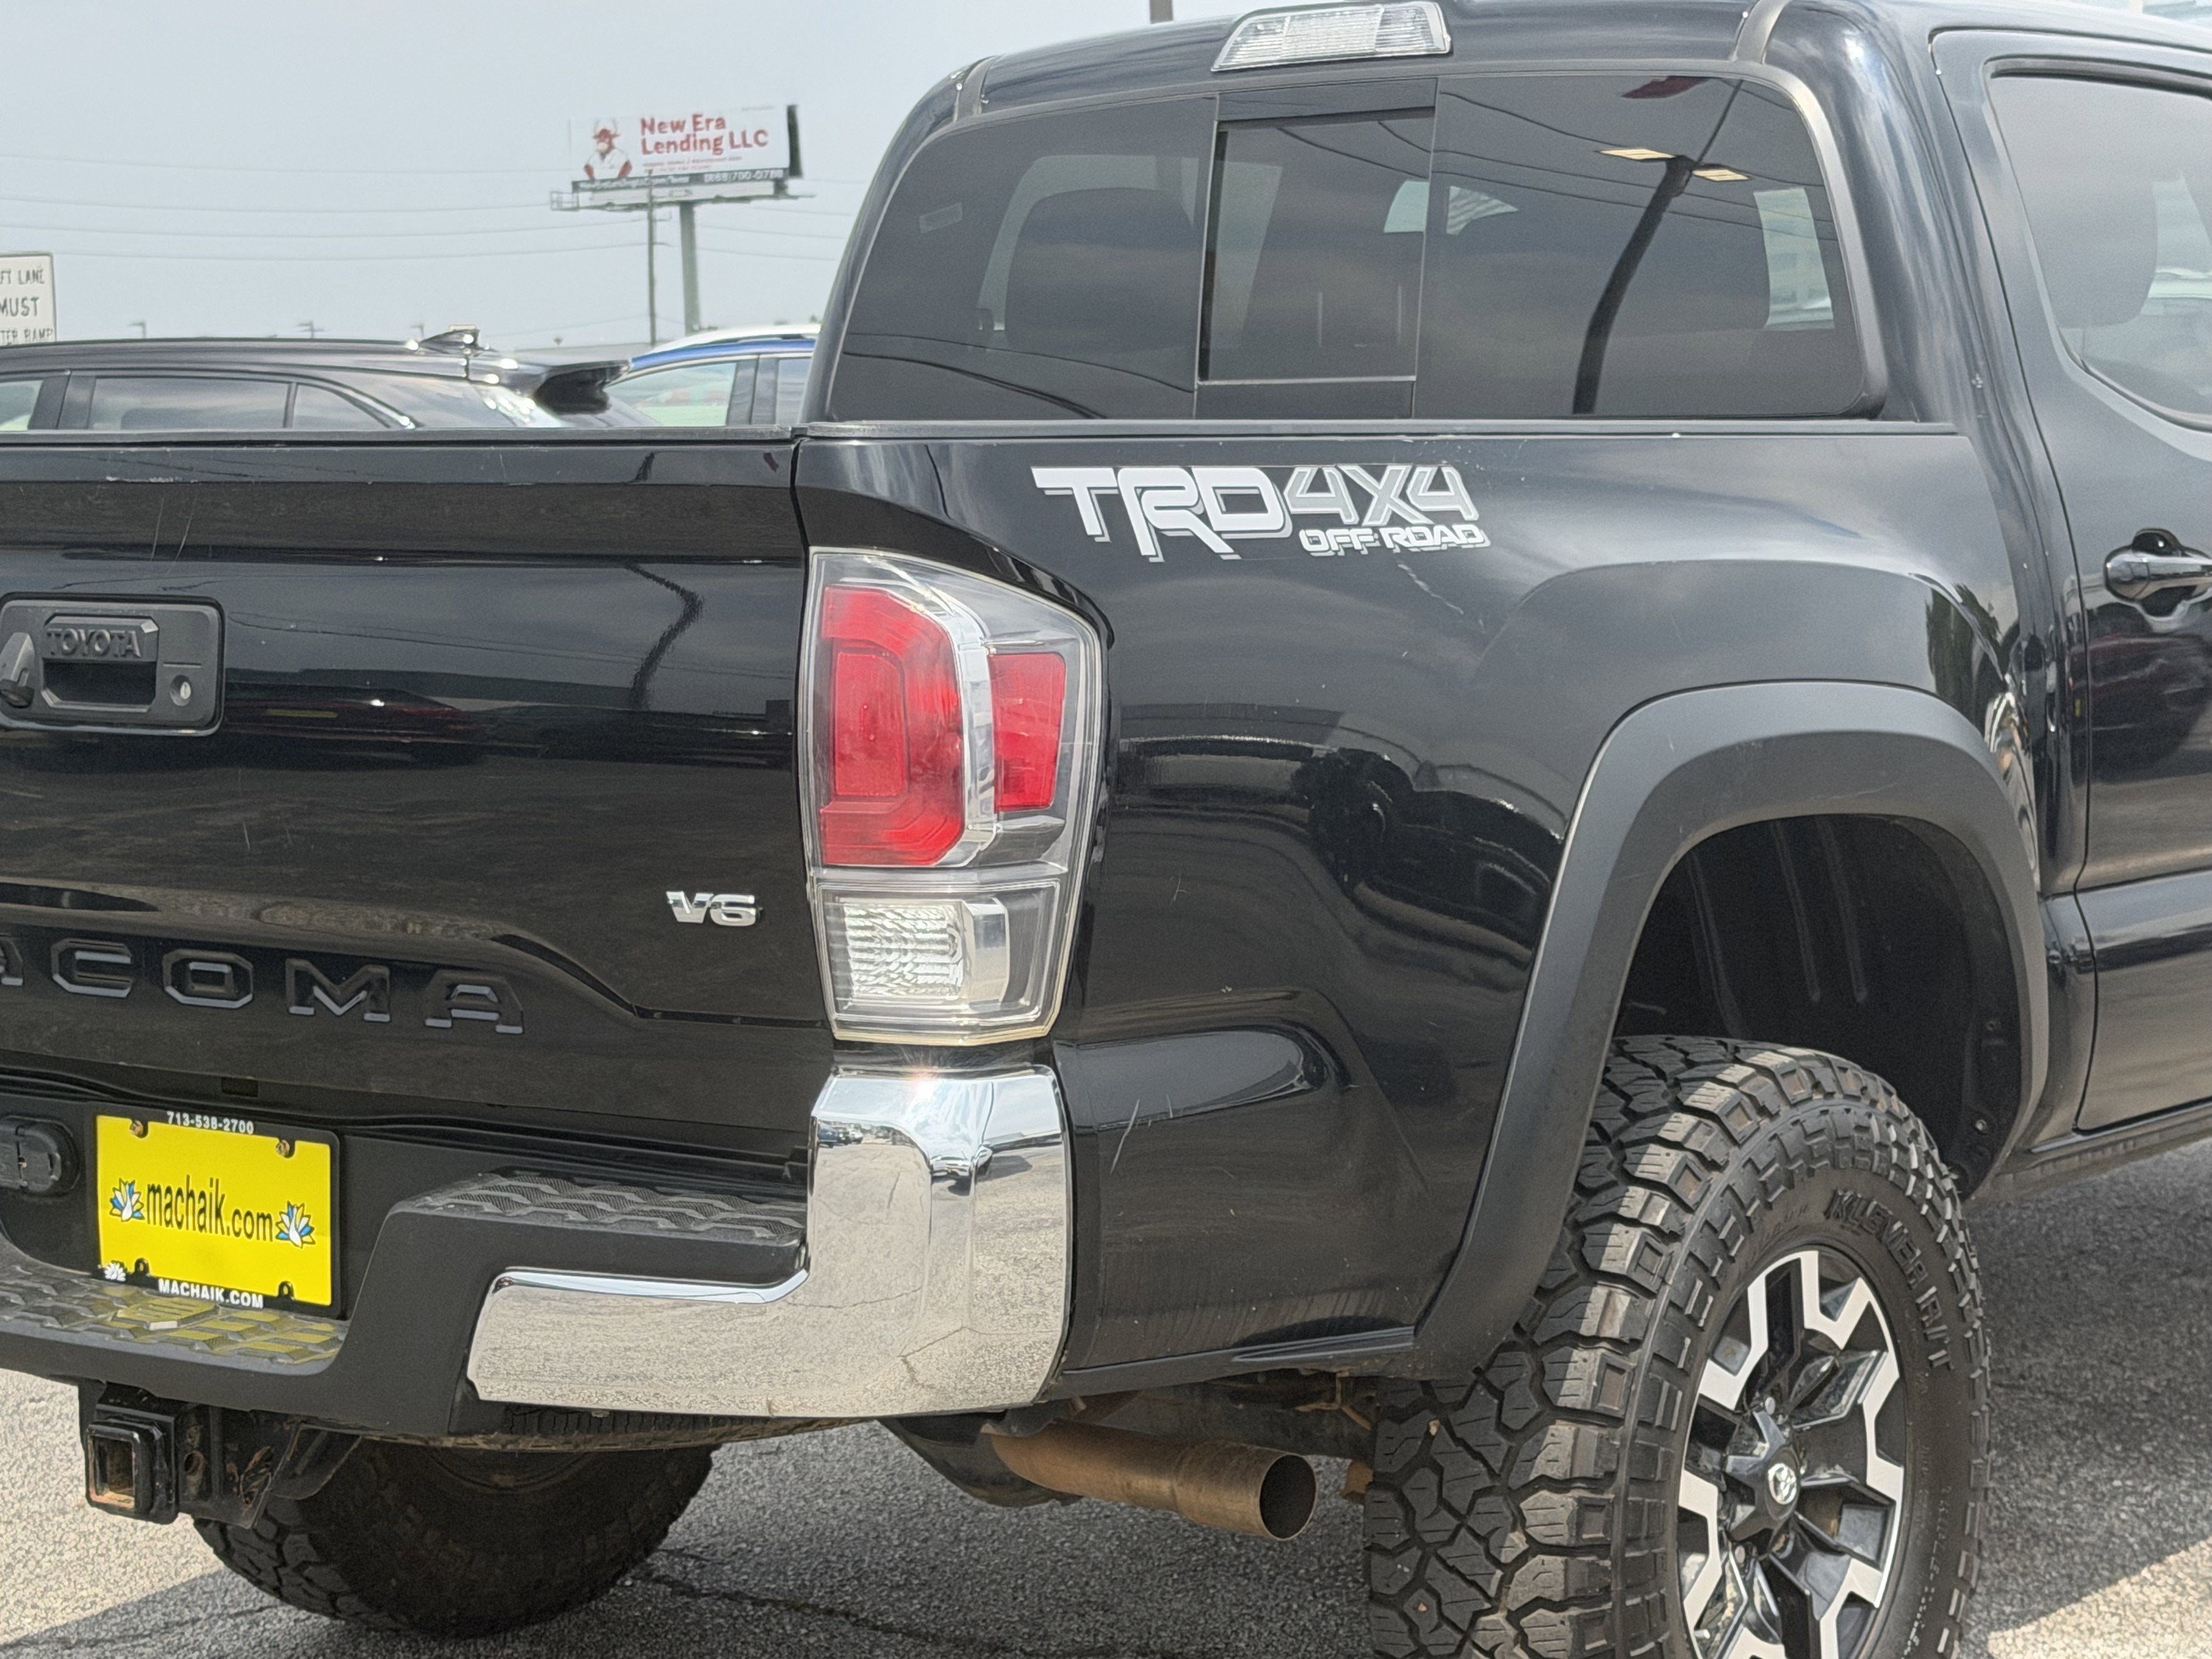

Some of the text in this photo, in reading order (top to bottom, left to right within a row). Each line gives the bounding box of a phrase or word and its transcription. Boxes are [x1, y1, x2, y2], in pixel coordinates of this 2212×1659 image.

[641, 114, 726, 136] New Era
[641, 129, 769, 156] Lending LLC
[0, 297, 40, 317] MUST
[1031, 466, 1293, 562] TRD
[1299, 523, 1491, 557] OFF ROAD
[46, 628, 141, 657] TOYOTA
[665, 890, 757, 927] V6
[0, 935, 524, 1034] COMA
[166, 1110, 254, 1135] 713-538-2700
[146, 1174, 273, 1242] machaik.com
[159, 1278, 263, 1309] MACHAIK.COM
